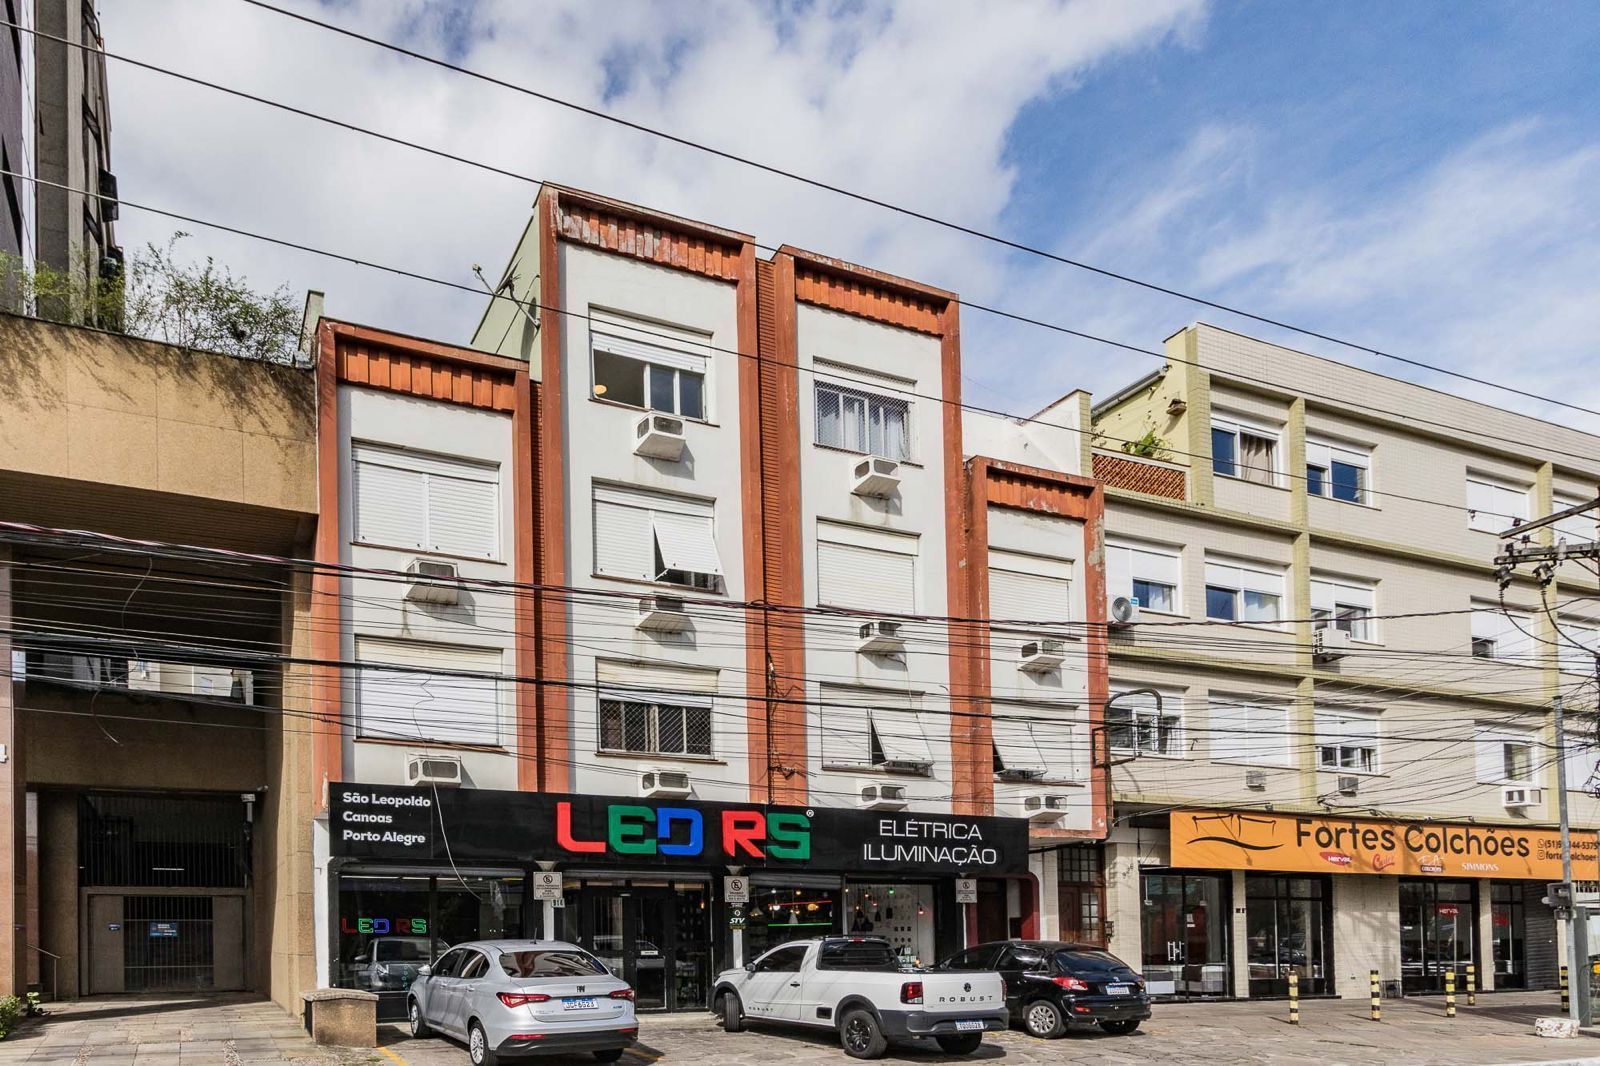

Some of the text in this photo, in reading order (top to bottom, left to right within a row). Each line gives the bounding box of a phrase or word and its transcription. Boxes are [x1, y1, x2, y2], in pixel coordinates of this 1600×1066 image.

[343, 792, 431, 808] São Leopoldo
[343, 811, 393, 823] Canoas
[343, 829, 426, 846] Porto Alegre
[557, 801, 811, 859] LED RS
[880, 818, 983, 841] ELÉTRICA
[1296, 818, 1529, 857] Fortes Colchões
[864, 843, 997, 866] ILUMINAÇÃO
[342, 918, 427, 933] LED RS
